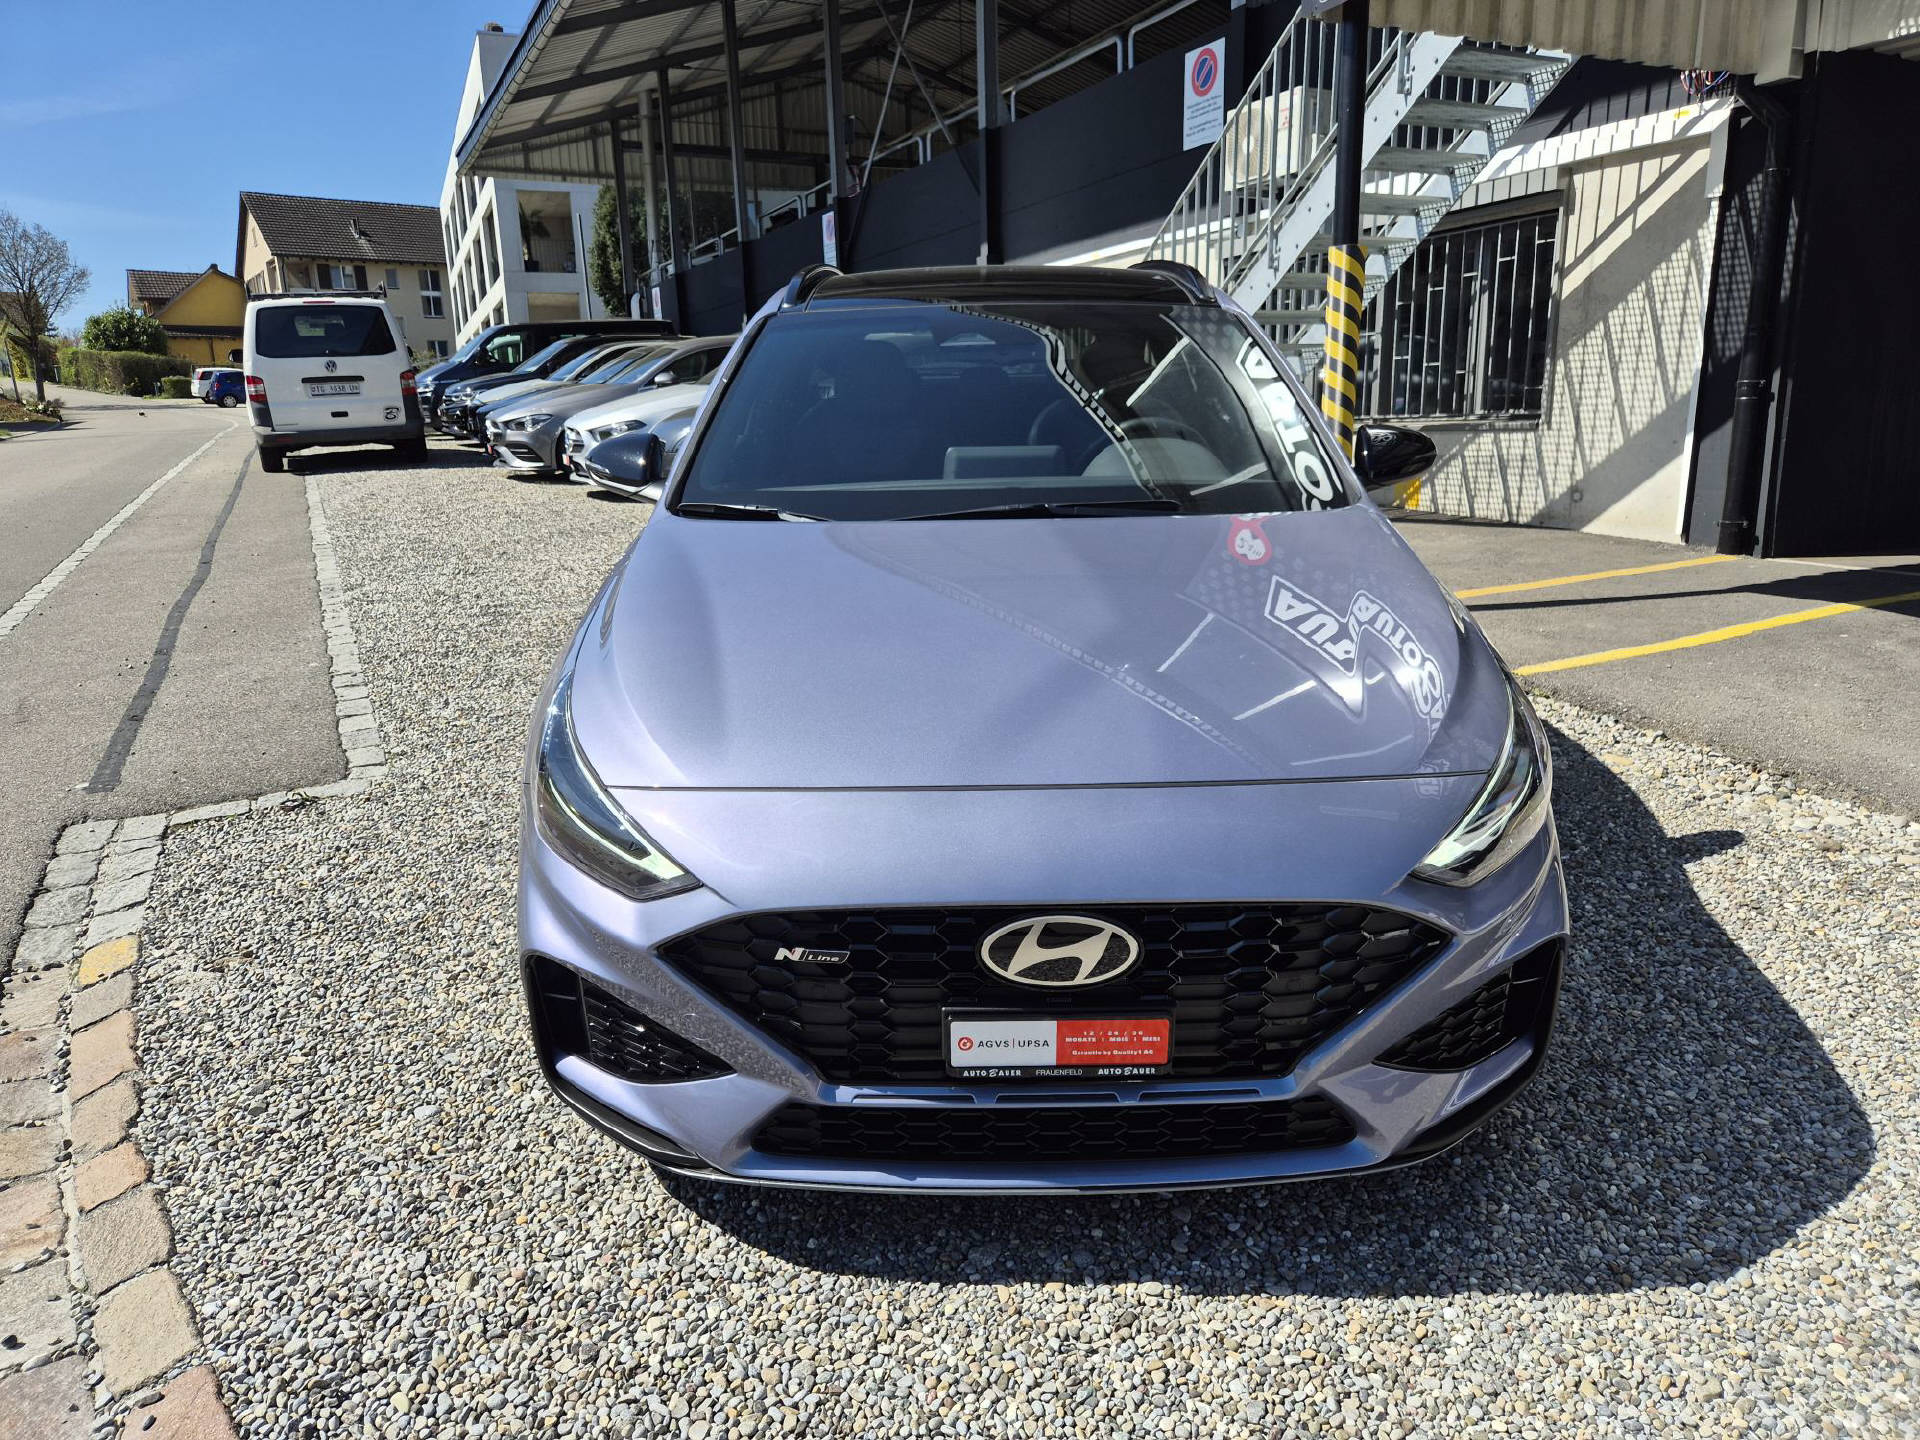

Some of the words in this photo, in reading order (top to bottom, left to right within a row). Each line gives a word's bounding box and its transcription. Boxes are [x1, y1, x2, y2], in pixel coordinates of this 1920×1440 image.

[807, 954, 840, 962] Line
[977, 1039, 1010, 1048] AGVS
[1018, 1039, 1050, 1048] UPSA
